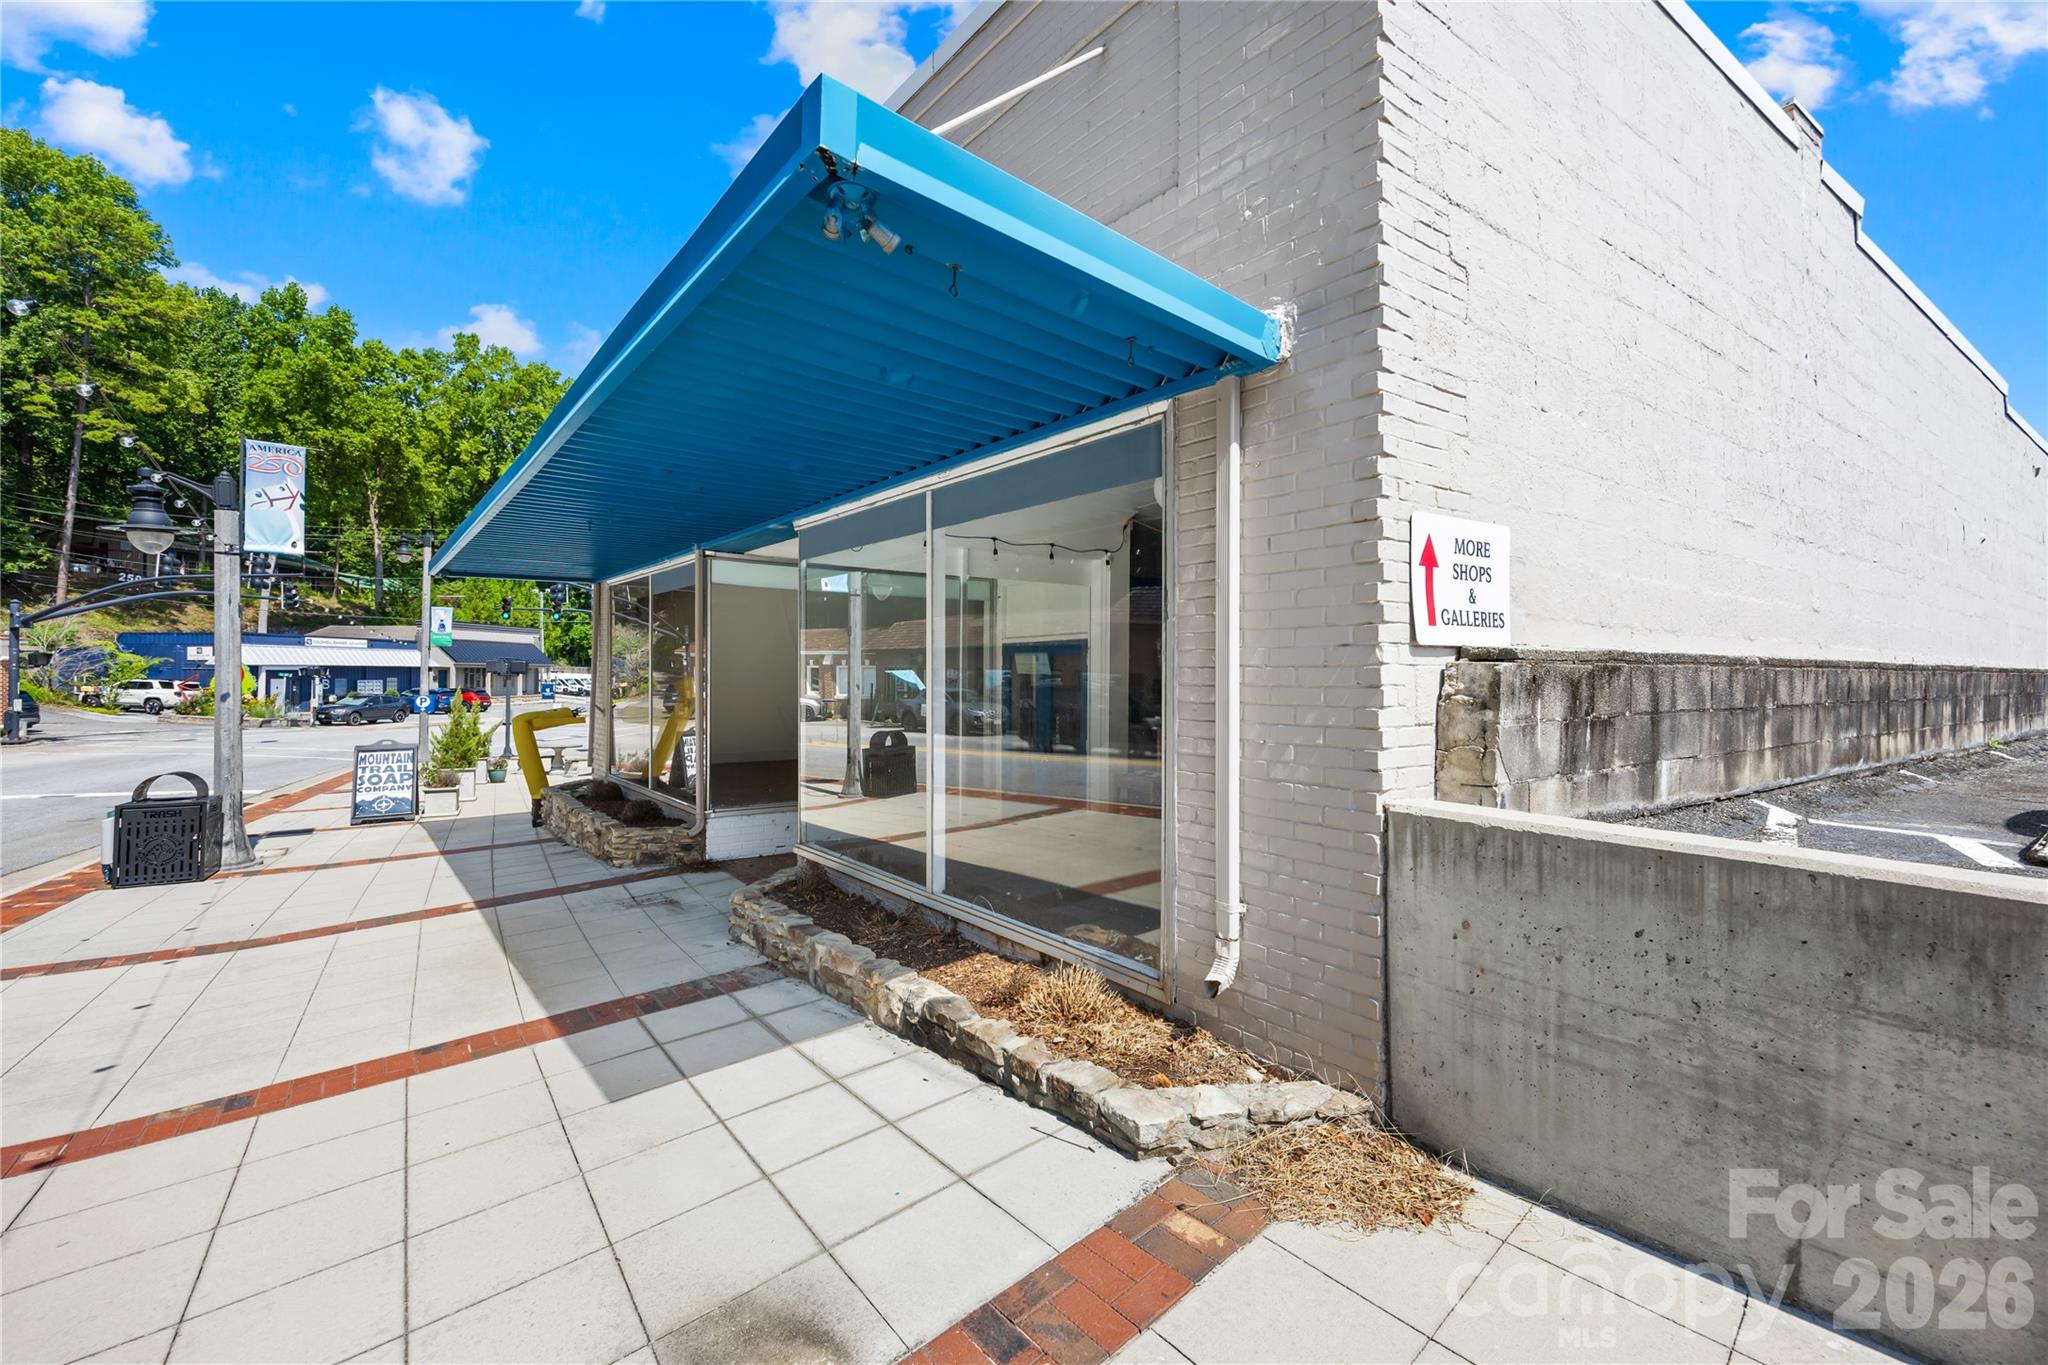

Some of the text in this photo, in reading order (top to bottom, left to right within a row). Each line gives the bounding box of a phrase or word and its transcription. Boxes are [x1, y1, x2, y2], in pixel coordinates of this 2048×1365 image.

[249, 444, 302, 457] AMERICA
[1453, 537, 1491, 558] MORE
[1452, 562, 1492, 583] SHOPS
[1468, 588, 1477, 604] &
[1440, 608, 1505, 629] GALLERIES
[419, 696, 428, 706] P
[359, 753, 414, 765] MOUNTAIN
[359, 765, 413, 774] TRAIL
[358, 773, 413, 786] SOAP
[357, 785, 413, 793] COMPANY
[142, 810, 182, 819] TRASH
